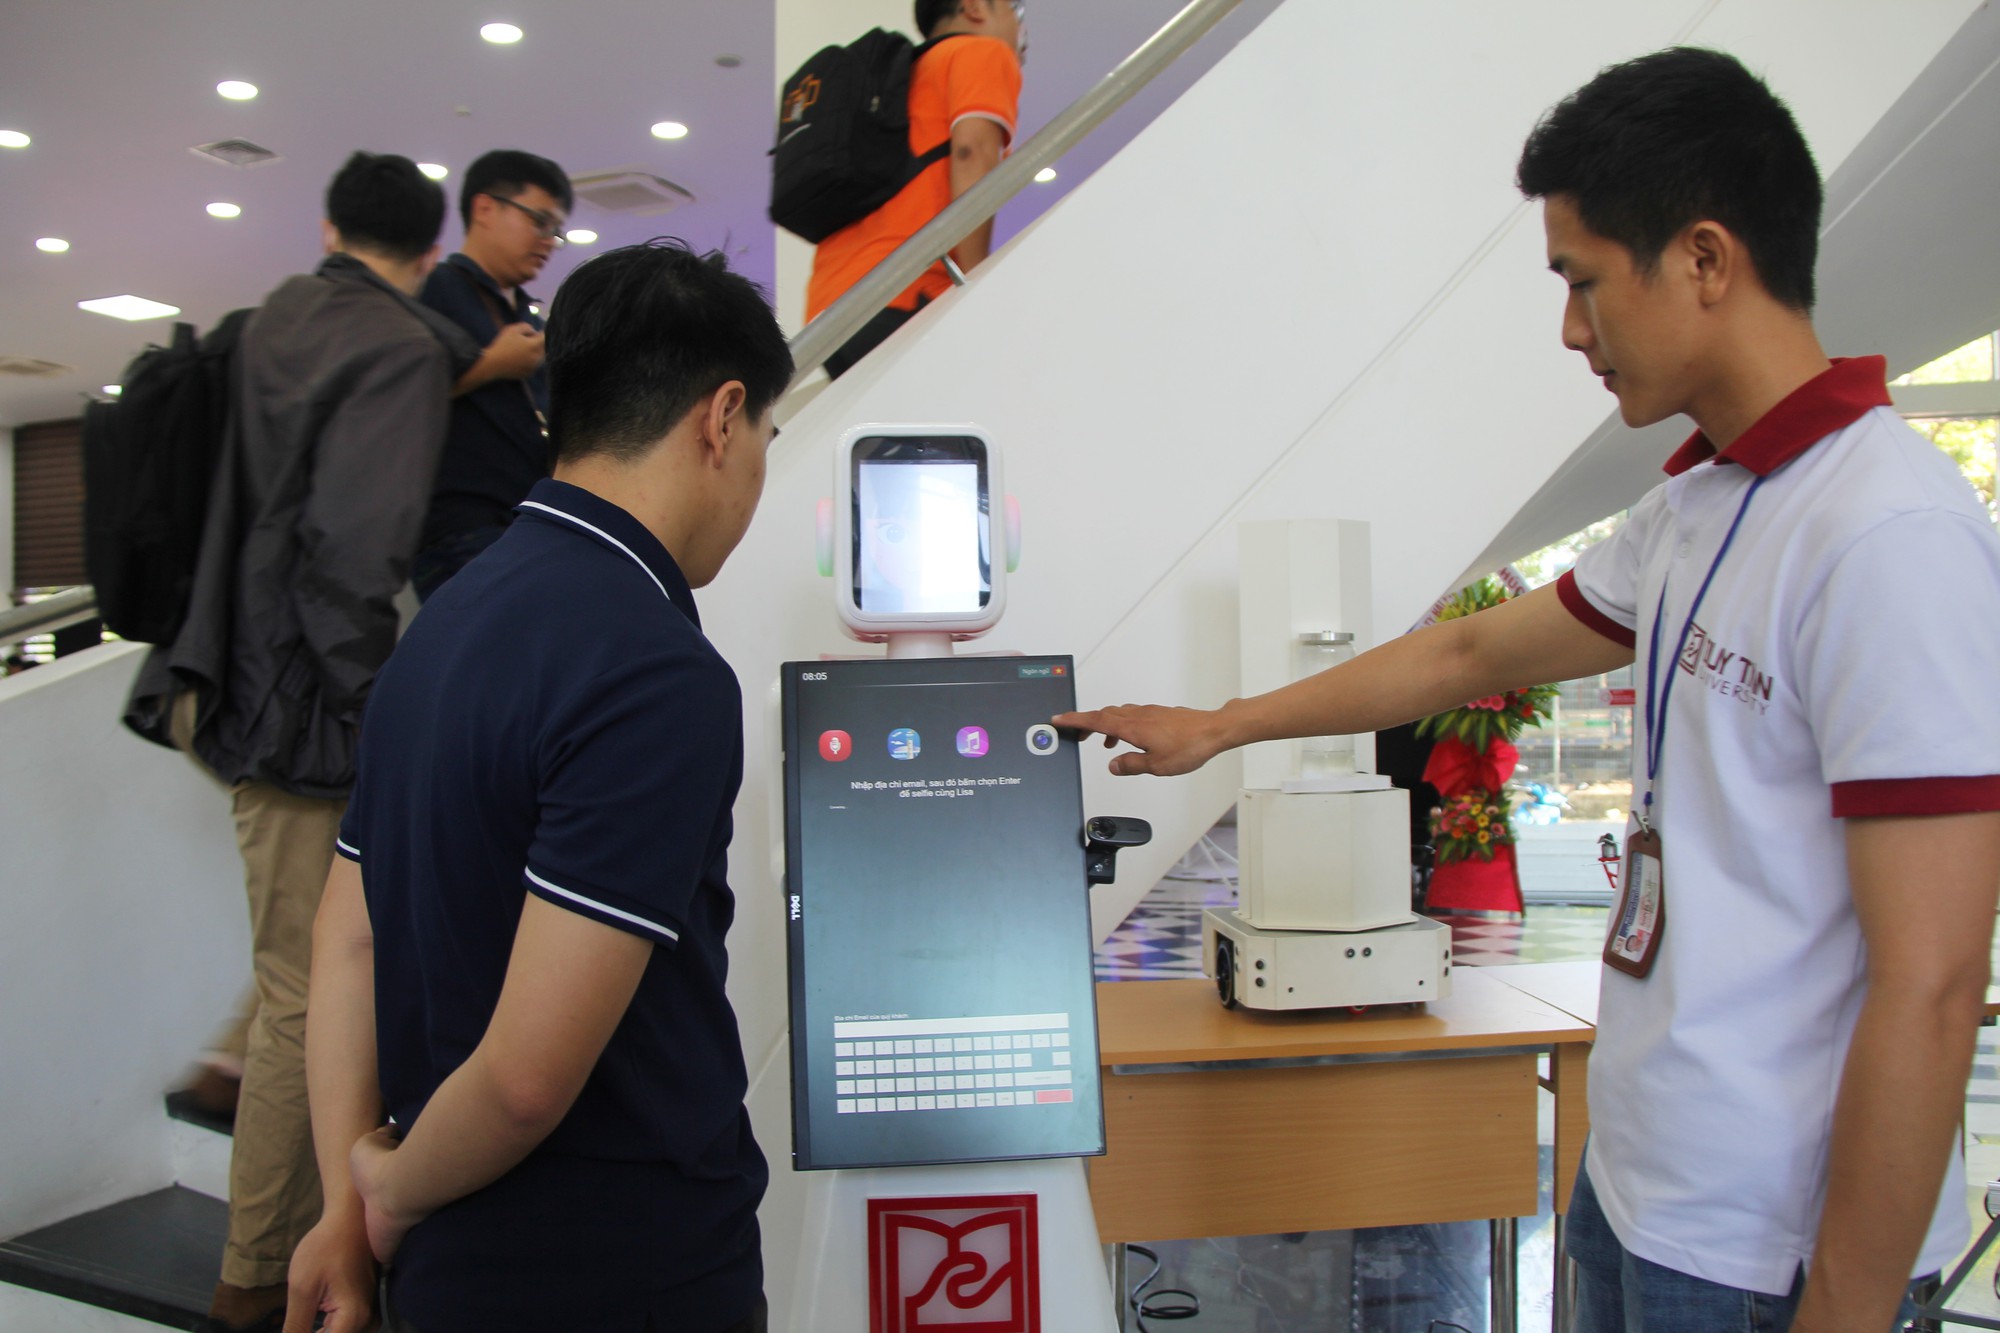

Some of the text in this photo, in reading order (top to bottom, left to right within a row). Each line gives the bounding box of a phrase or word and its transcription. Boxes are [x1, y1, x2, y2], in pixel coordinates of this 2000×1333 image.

[802, 672, 828, 681] 08:05
[851, 781, 873, 791] Nhập
[902, 779, 928, 788] email,
[929, 779, 944, 787] sau
[945, 778, 957, 786] đó
[977, 778, 998, 787] chọn
[999, 777, 1021, 785] Enter
[911, 789, 934, 798] selfie
[935, 788, 956, 798] cùng
[957, 788, 974, 796] Lisa
[790, 895, 801, 920] DELL
